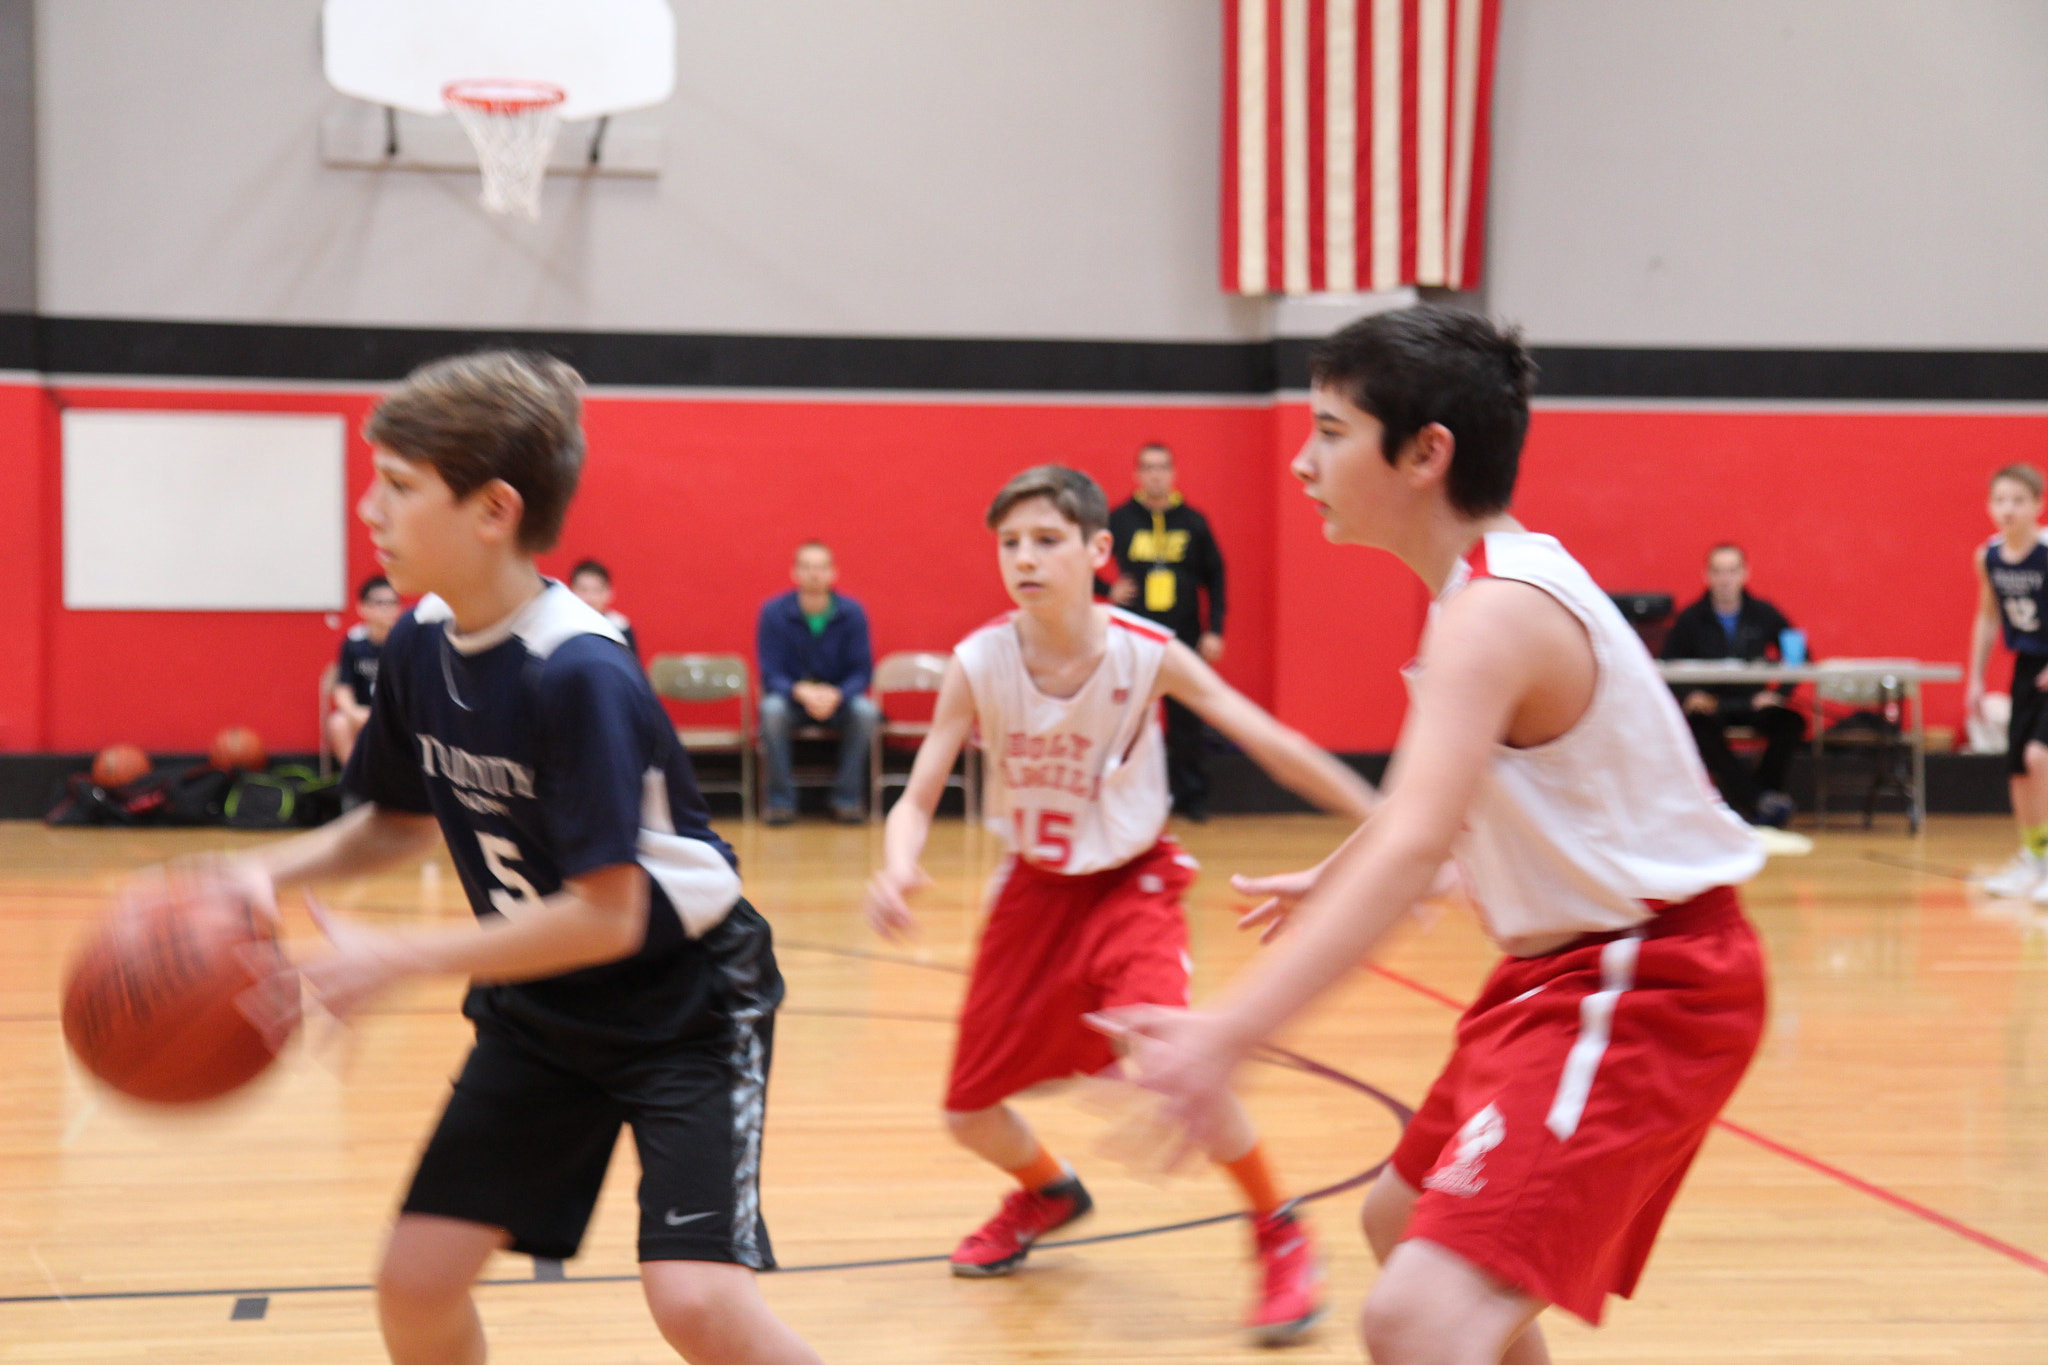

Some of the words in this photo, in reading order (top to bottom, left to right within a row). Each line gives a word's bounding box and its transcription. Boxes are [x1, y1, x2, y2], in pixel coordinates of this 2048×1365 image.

[1128, 529, 1191, 562] NKE
[1012, 808, 1075, 871] 15
[474, 829, 548, 922] 5
